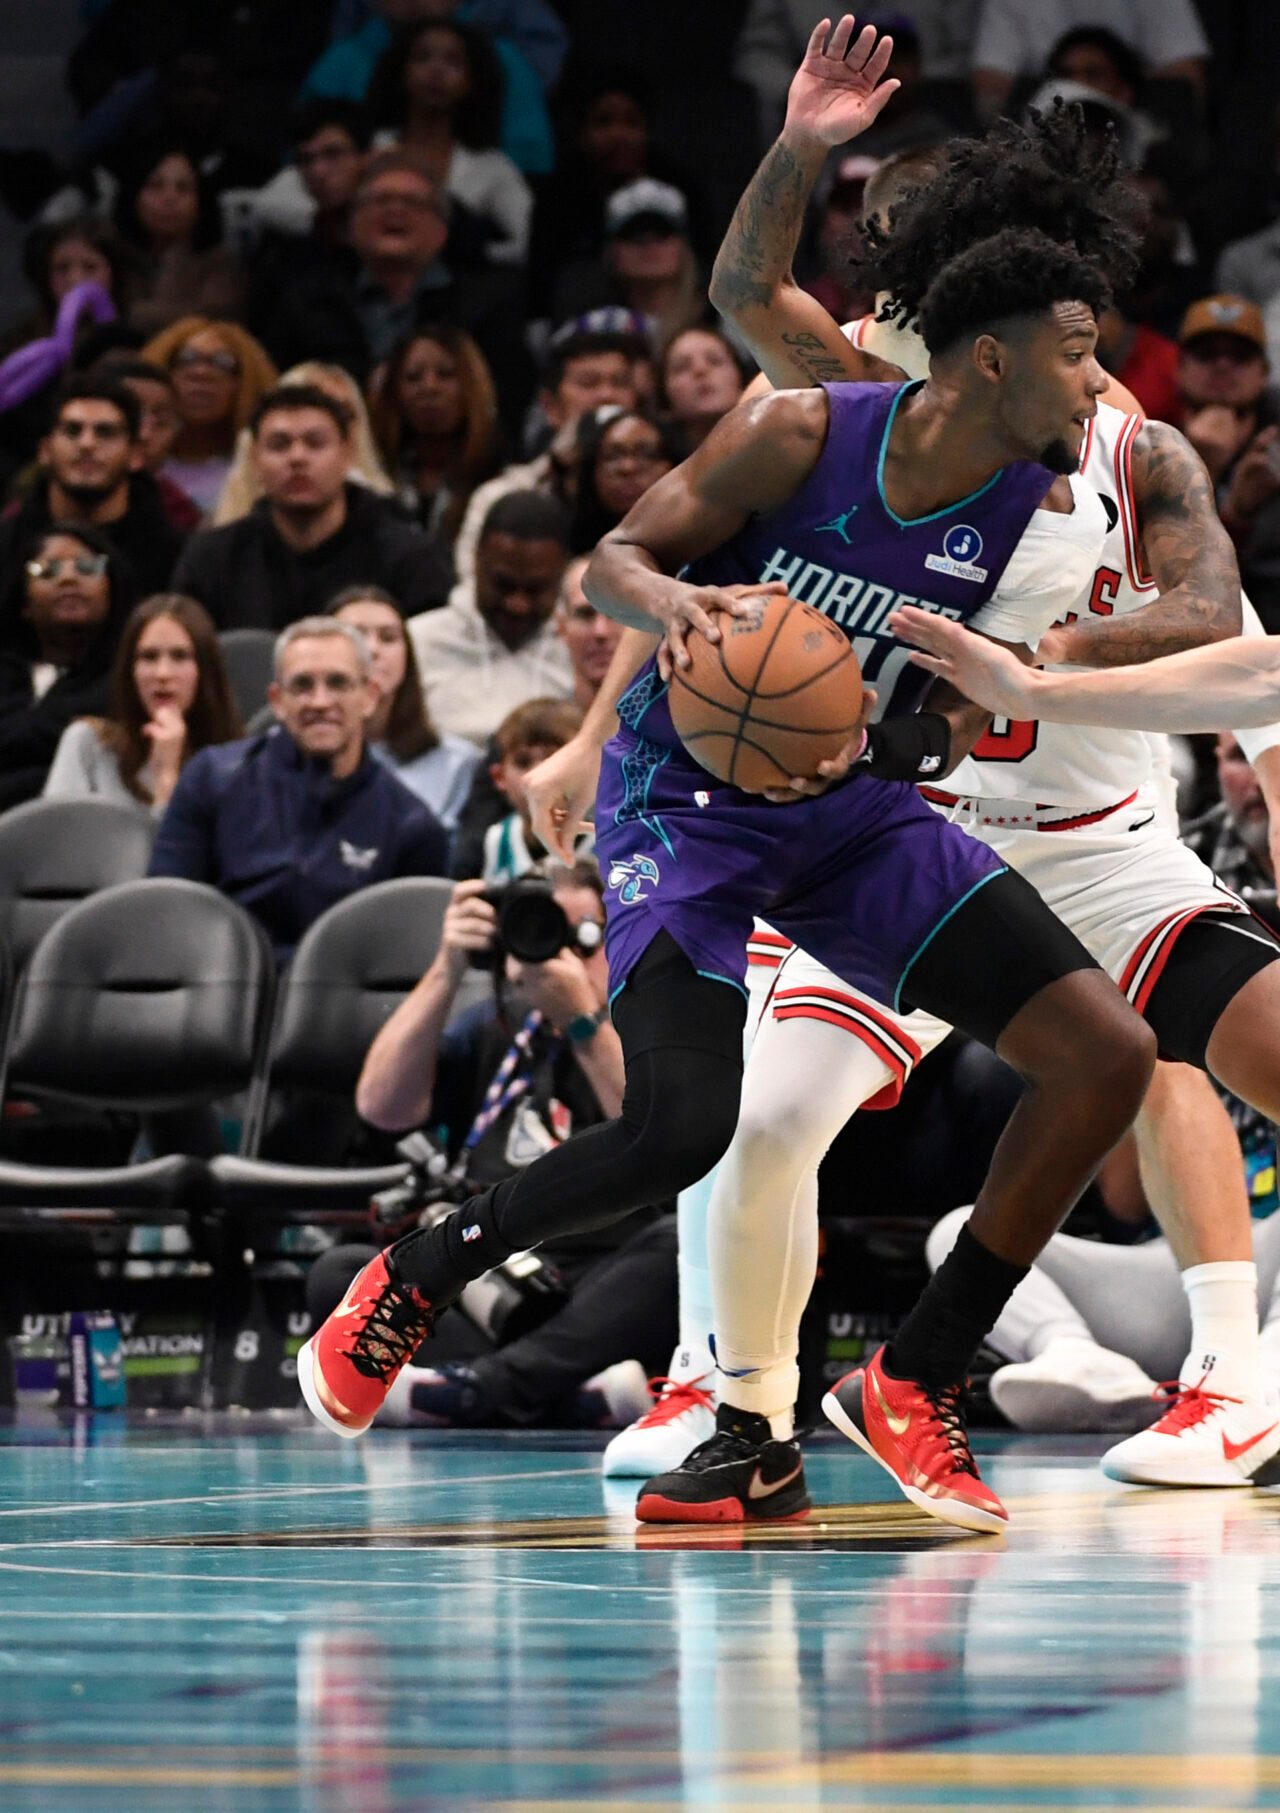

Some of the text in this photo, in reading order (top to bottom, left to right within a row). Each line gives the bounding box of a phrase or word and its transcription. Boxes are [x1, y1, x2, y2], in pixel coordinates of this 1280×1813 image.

[927, 557, 985, 581] Judi Health
[235, 1331, 258, 1360] 8
